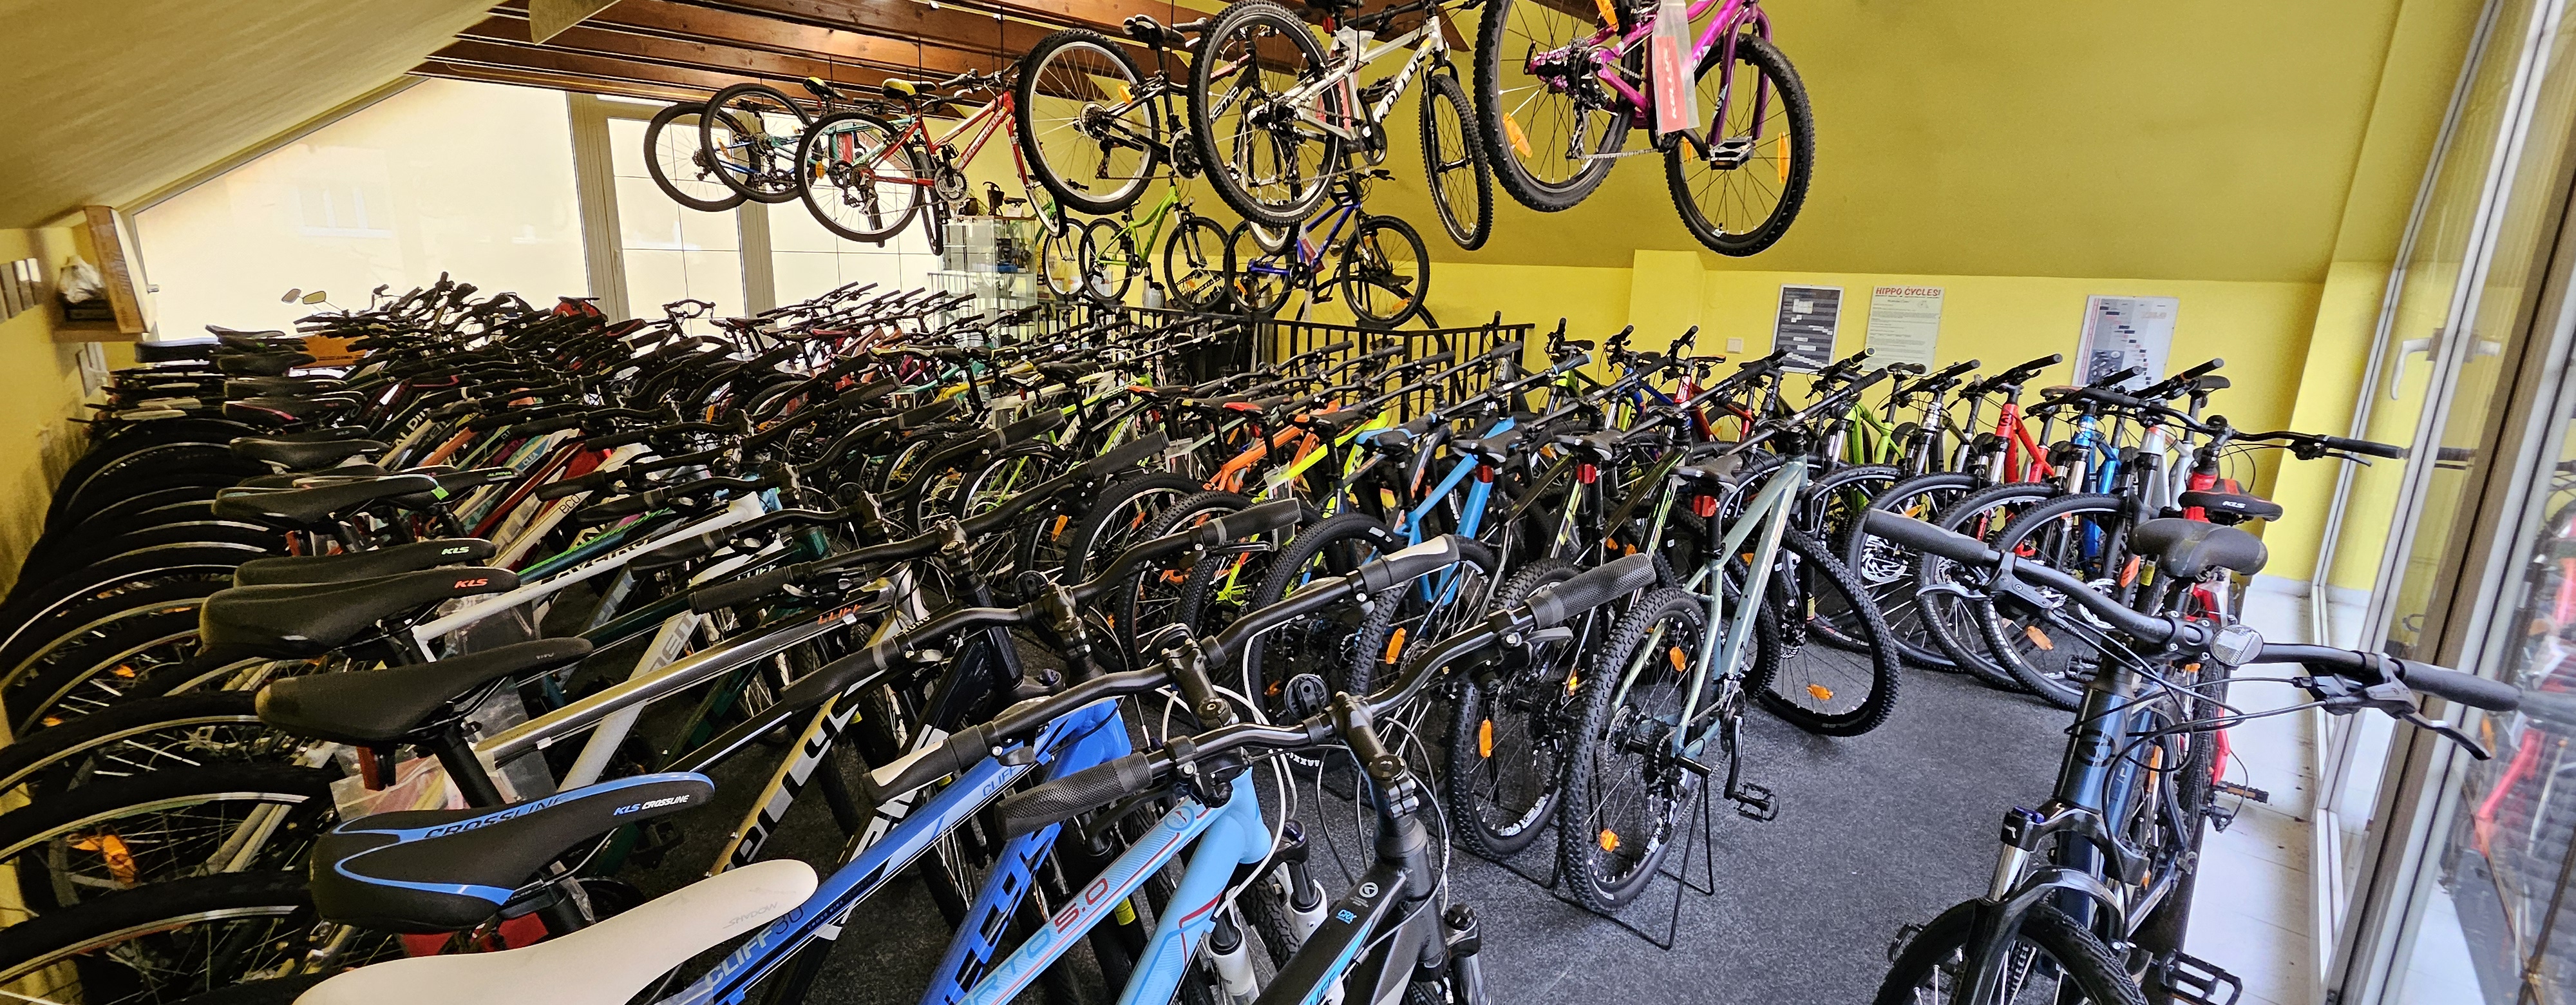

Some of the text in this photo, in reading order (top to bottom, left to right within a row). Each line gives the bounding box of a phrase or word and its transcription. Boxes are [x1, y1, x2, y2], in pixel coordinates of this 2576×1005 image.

[1875, 287, 1902, 296] HIPPO
[2222, 501, 2246, 509] KLS
[440, 546, 469, 555] KLS
[453, 579, 489, 589] KLS
[614, 794, 690, 816] KLS CROSSLINE
